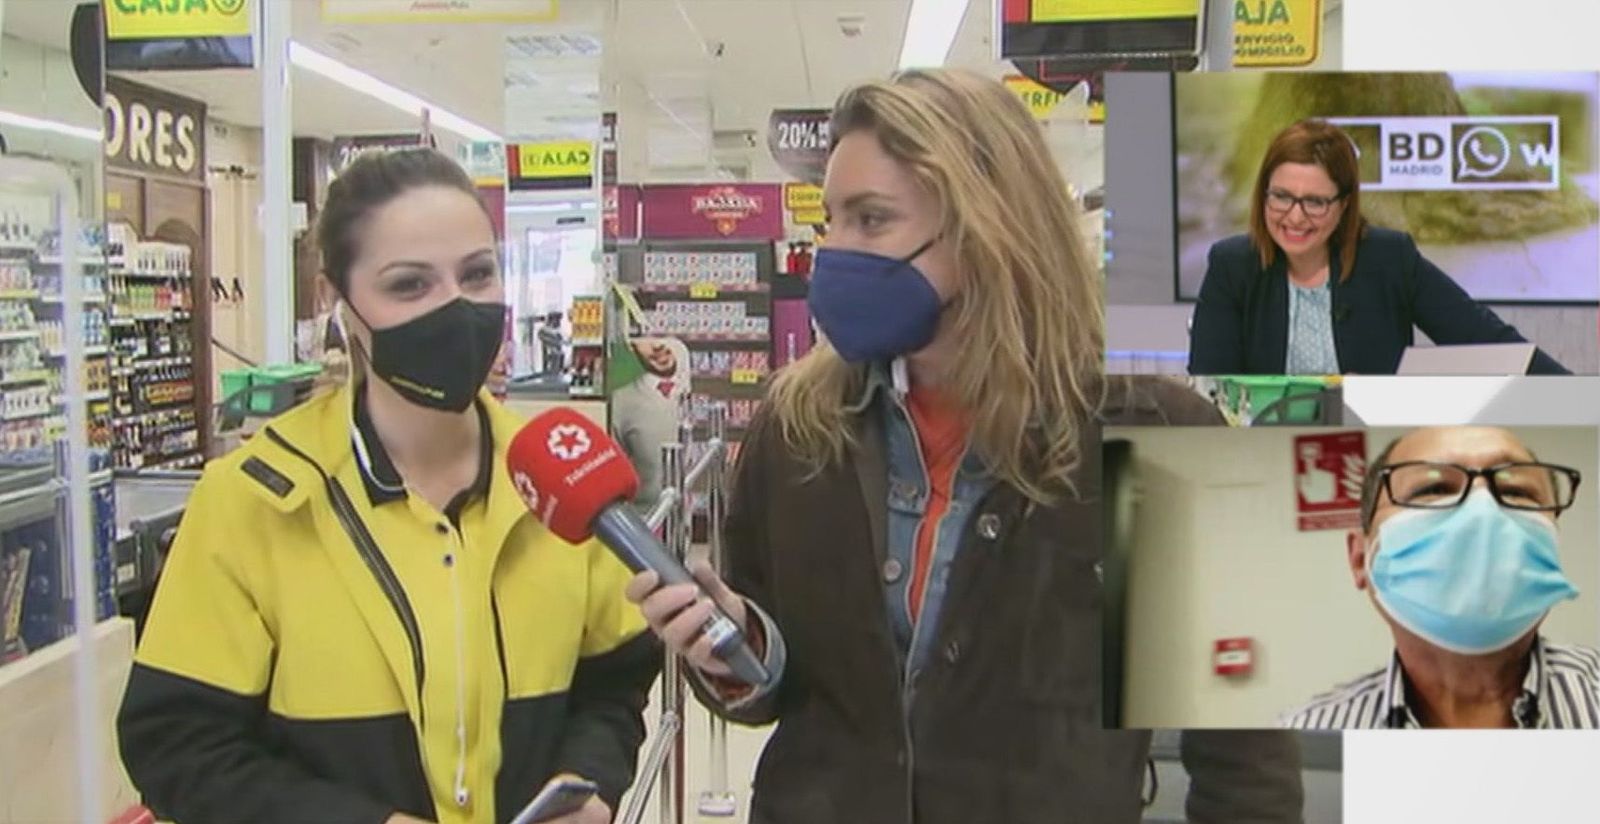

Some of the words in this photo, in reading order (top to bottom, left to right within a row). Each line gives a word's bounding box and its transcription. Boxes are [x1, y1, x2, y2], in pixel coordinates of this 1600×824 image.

[778, 120, 817, 149] 20%
[1389, 133, 1445, 160] BD
[1389, 165, 1443, 176] MADRID
